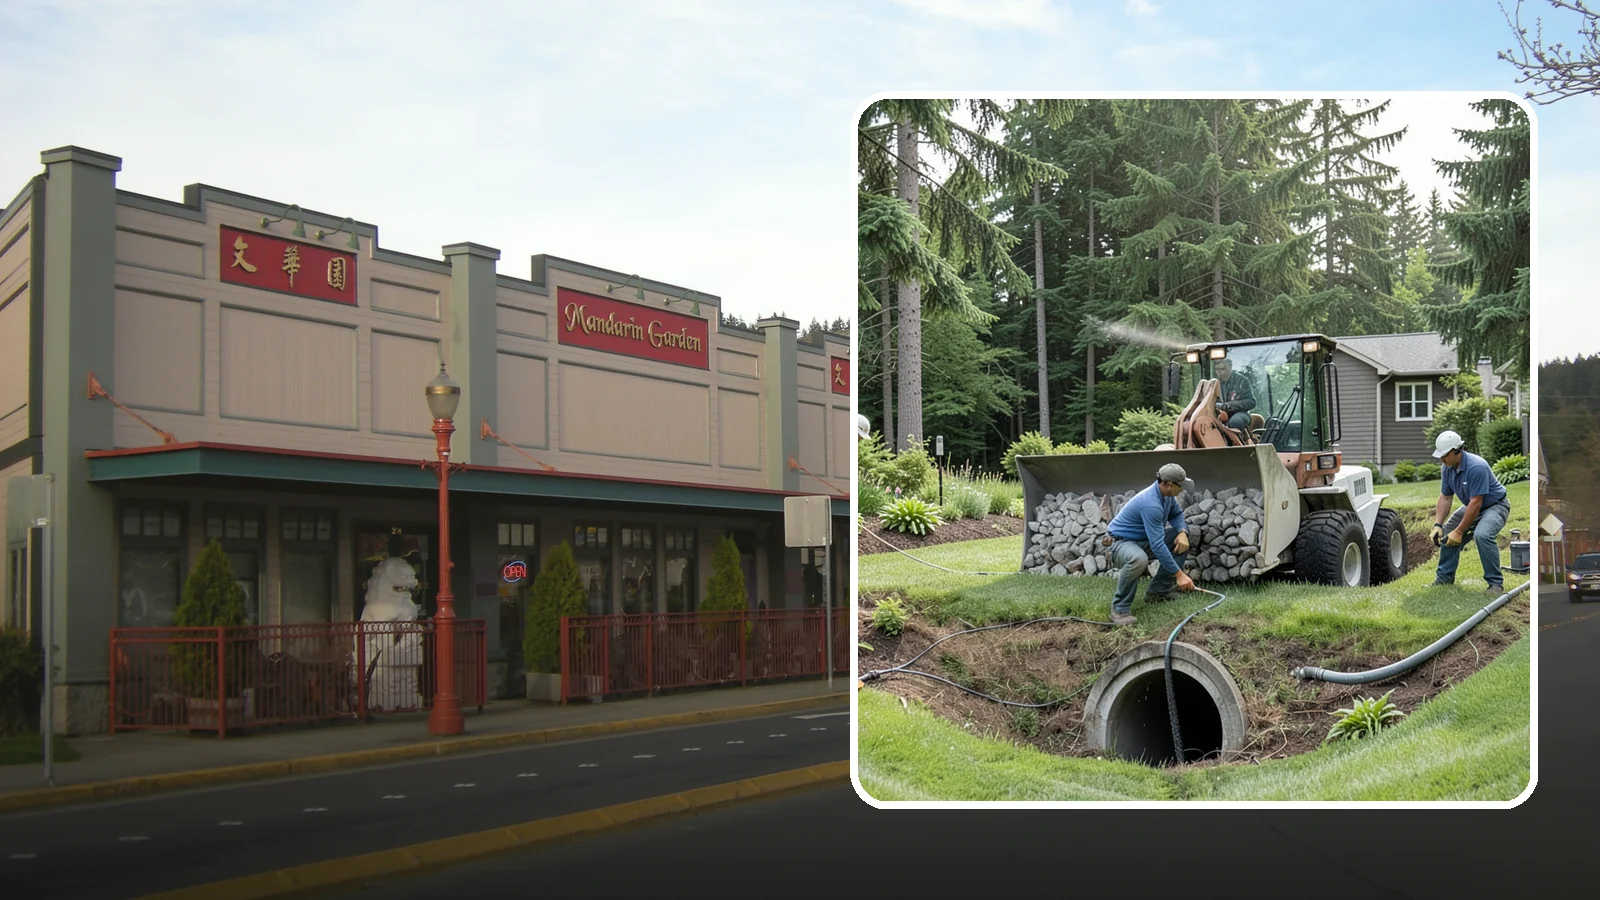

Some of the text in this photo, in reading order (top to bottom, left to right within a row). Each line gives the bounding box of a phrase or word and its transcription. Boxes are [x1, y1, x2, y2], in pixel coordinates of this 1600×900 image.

[231, 236, 346, 291] 文華園
[564, 302, 702, 352] Mandarin Garden
[503, 565, 527, 578] OPEN
